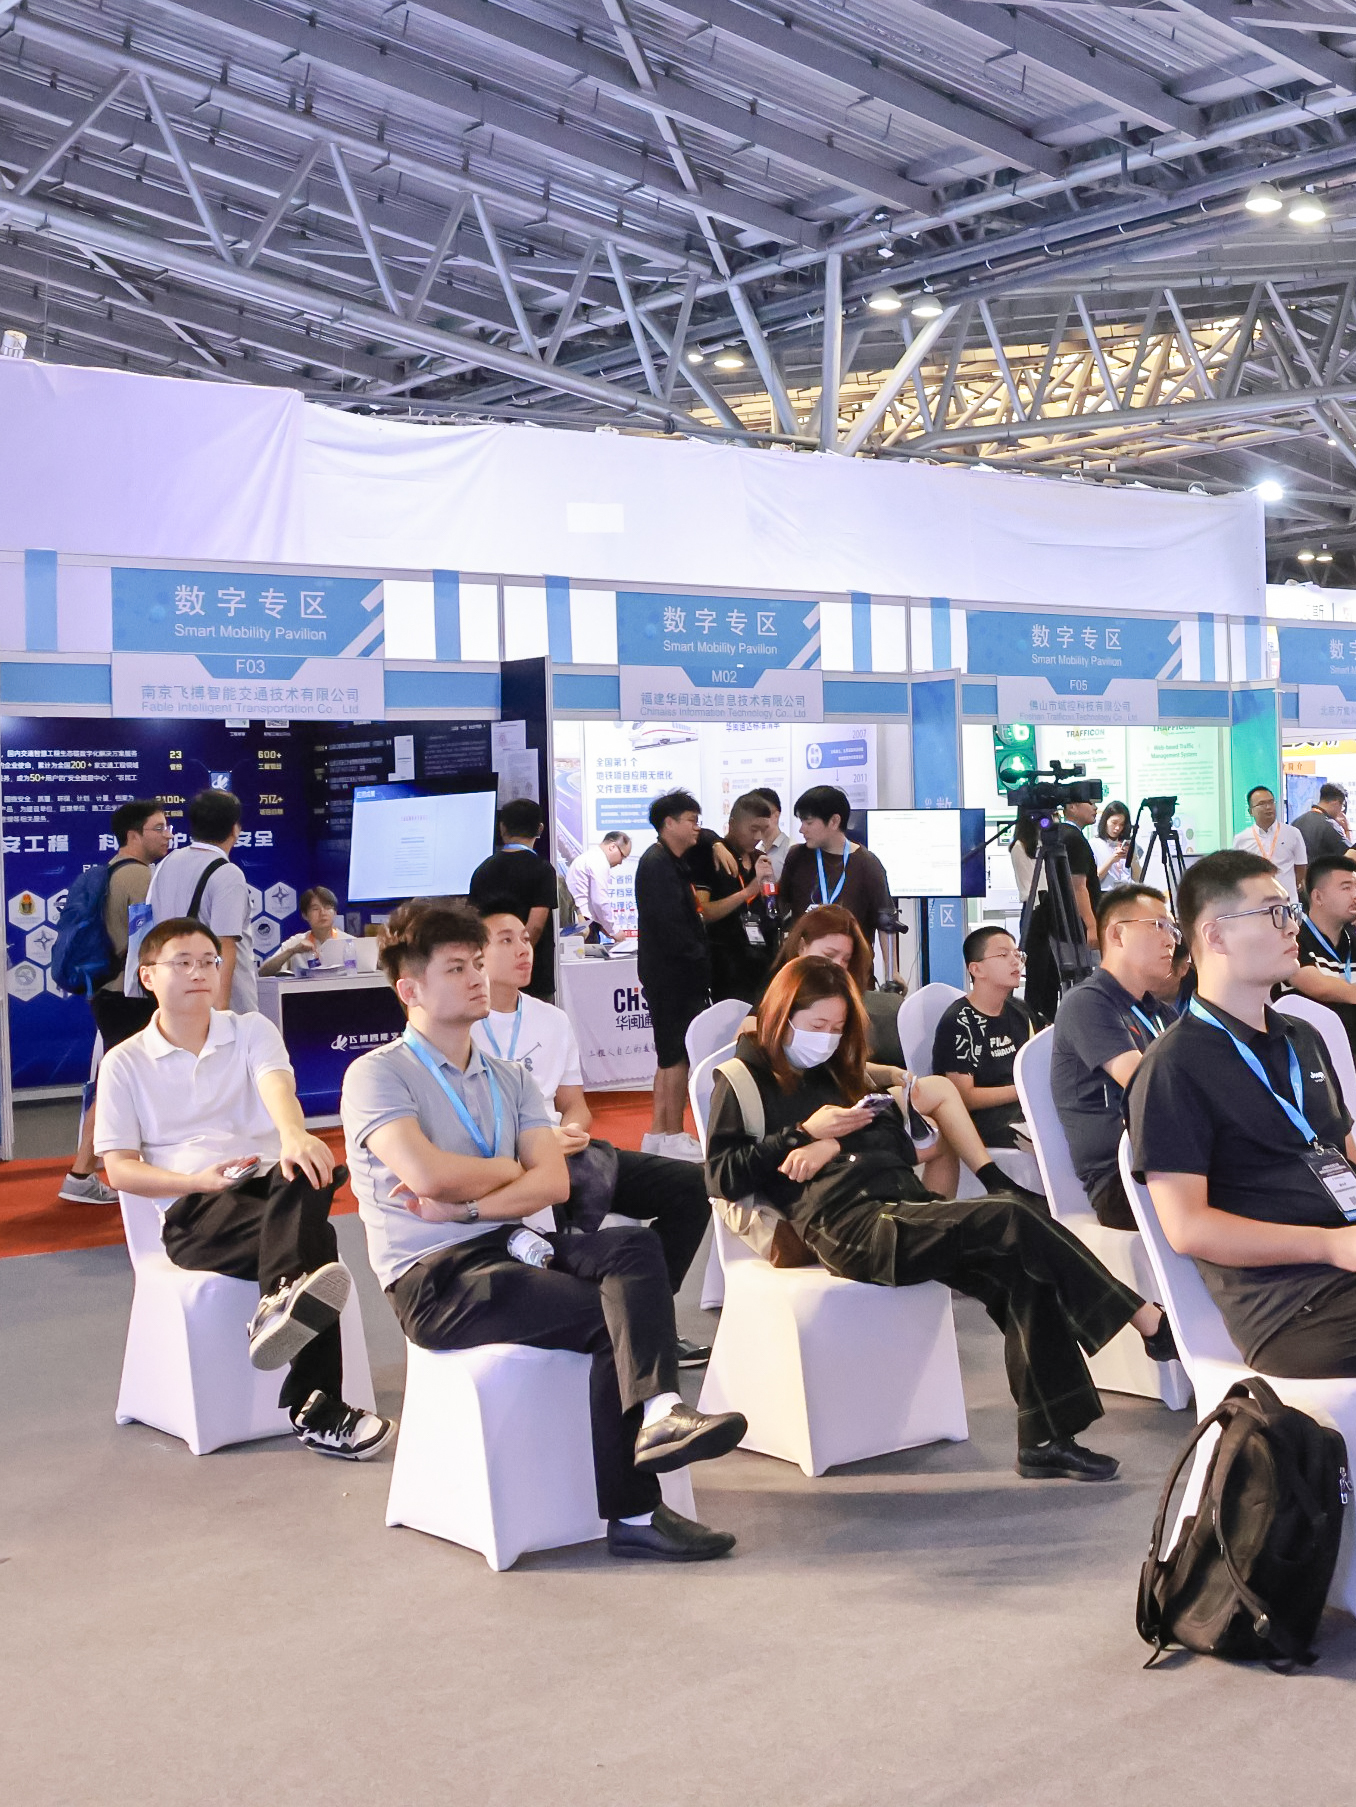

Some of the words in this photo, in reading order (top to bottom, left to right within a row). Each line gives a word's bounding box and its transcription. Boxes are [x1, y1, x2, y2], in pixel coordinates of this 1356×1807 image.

[174, 584, 327, 619] 数字专区
[663, 605, 778, 636] 数字专区
[174, 623, 216, 638] Smart
[219, 625, 271, 642] Mobility
[275, 626, 327, 641] Pavilion
[1031, 623, 1122, 650] 数字专区
[663, 639, 695, 652] Smart
[697, 641, 736, 656] Mobility
[738, 642, 778, 655] Pavilion
[236, 659, 266, 674] F03
[1031, 653, 1057, 665] Smart
[1058, 654, 1089, 668] Mobility
[1090, 655, 1122, 667] Pavilion
[711, 670, 737, 683] M02
[1330, 665, 1350, 675] Smart
[1069, 679, 1088, 691] F05
[141, 685, 359, 703] 南京飞搏智能交通技术有限公司
[641, 692, 805, 708] 福建华闽通达信息技术有限公司
[141, 702, 174, 713] Fable
[178, 703, 233, 715] Intelligent
[236, 703, 314, 715] Transportation
[679, 707, 727, 718] Information
[728, 708, 774, 720] Technology
[1066, 728, 1105, 738] TRAFFICON
[169, 750, 183, 759] 23
[258, 750, 282, 759] 600+
[596, 770, 674, 781] 地铁项目应用无纸化
[853, 773, 868, 783] 2011
[596, 784, 649, 794] 文件管理系统
[989, 1035, 1012, 1049] FILA
